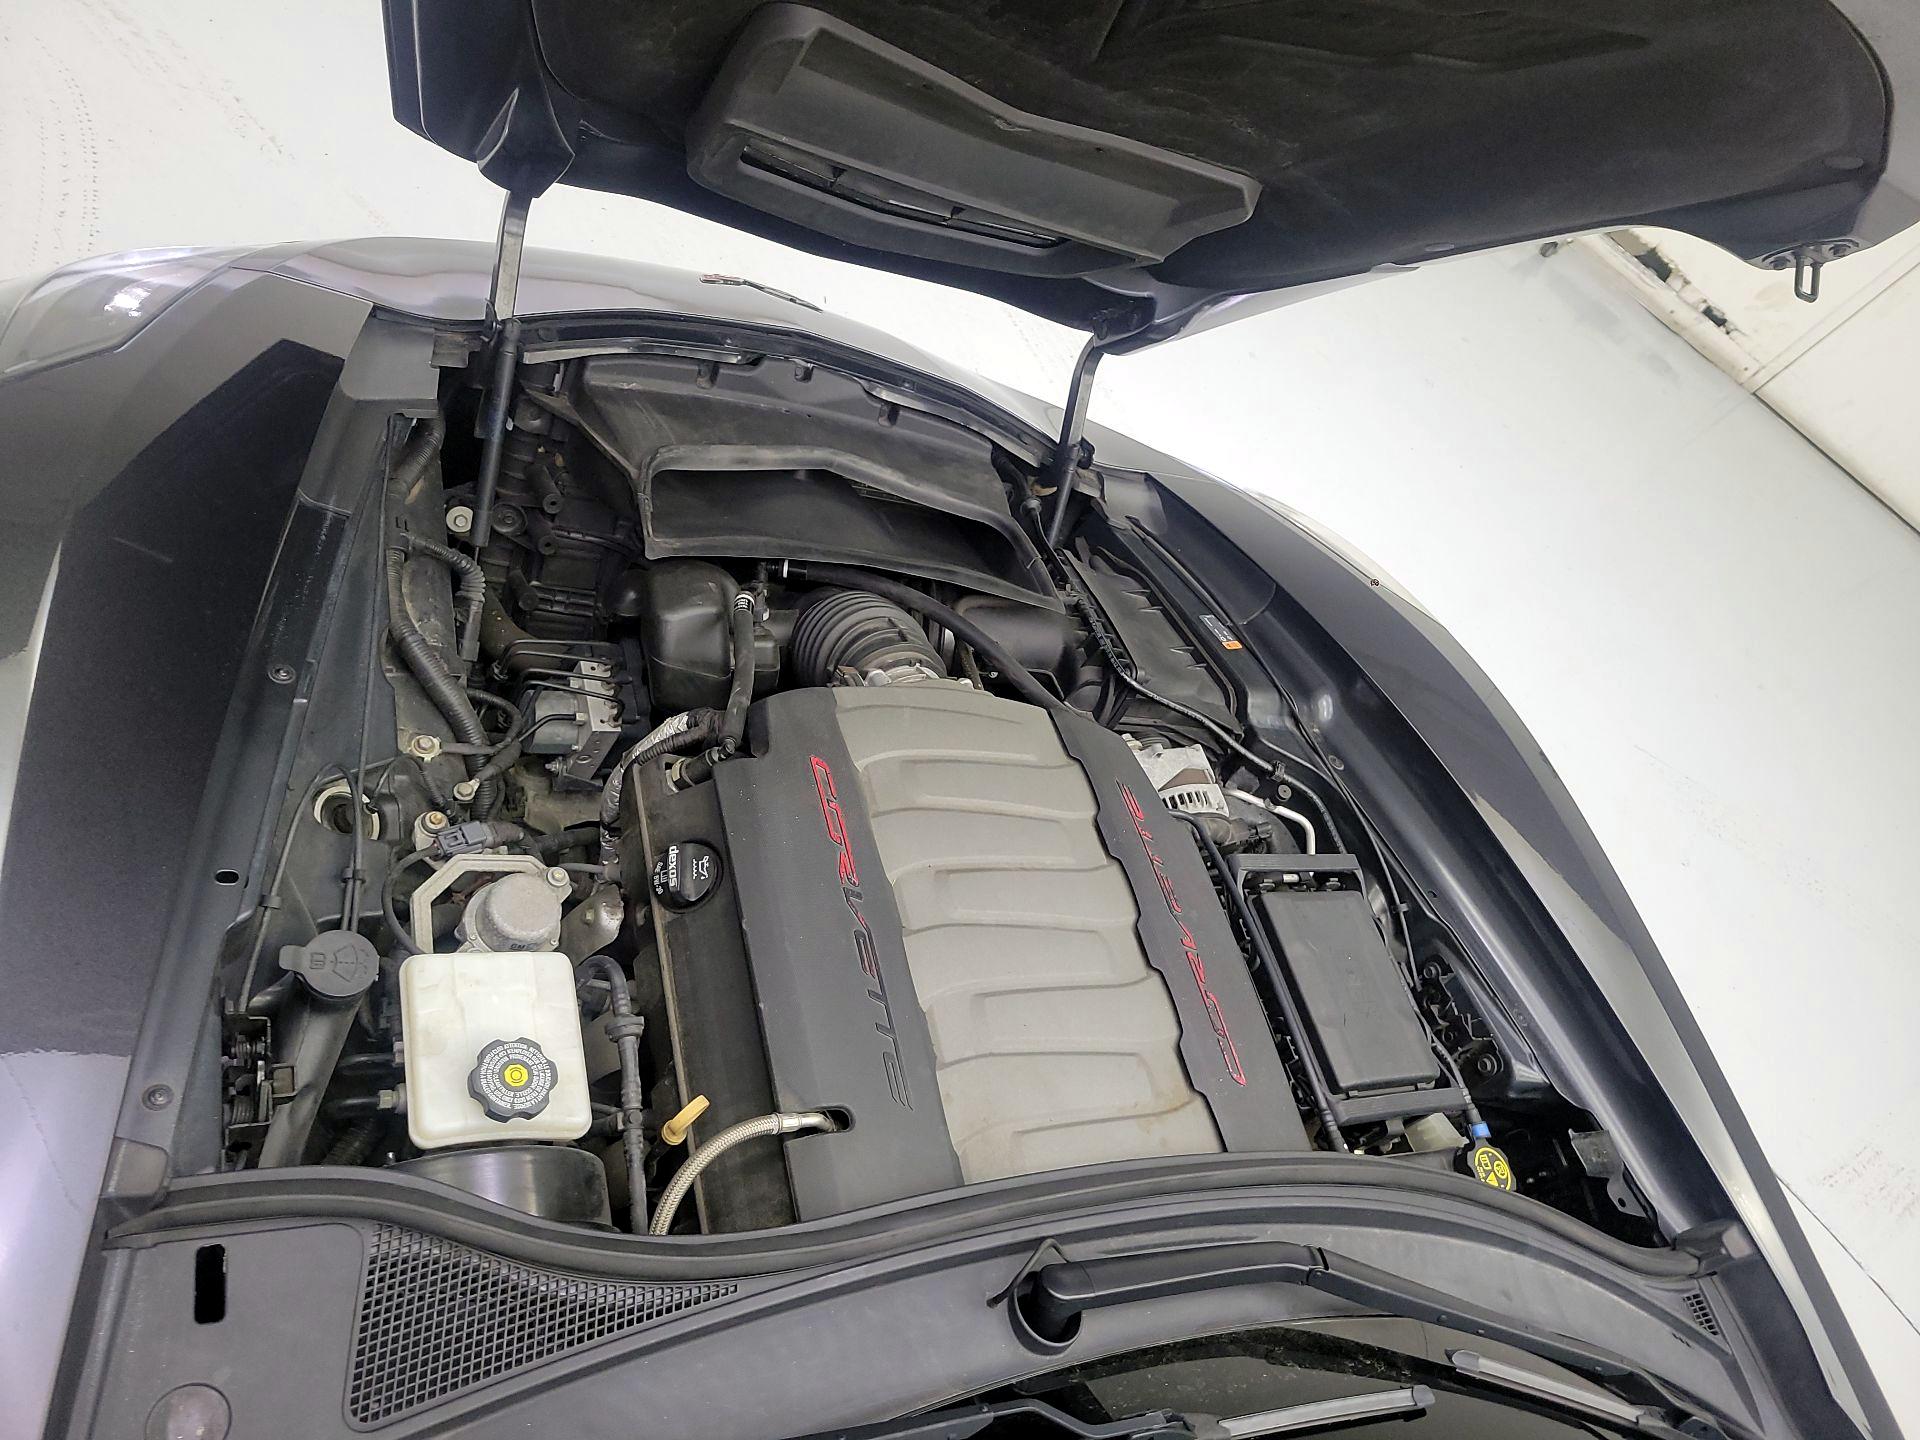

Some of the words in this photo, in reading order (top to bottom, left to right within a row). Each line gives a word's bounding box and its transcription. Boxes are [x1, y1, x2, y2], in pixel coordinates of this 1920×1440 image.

[668, 846, 679, 887] dexos
[811, 755, 914, 1112] CORVETTE
[1116, 779, 1246, 1085] CORVETTE
